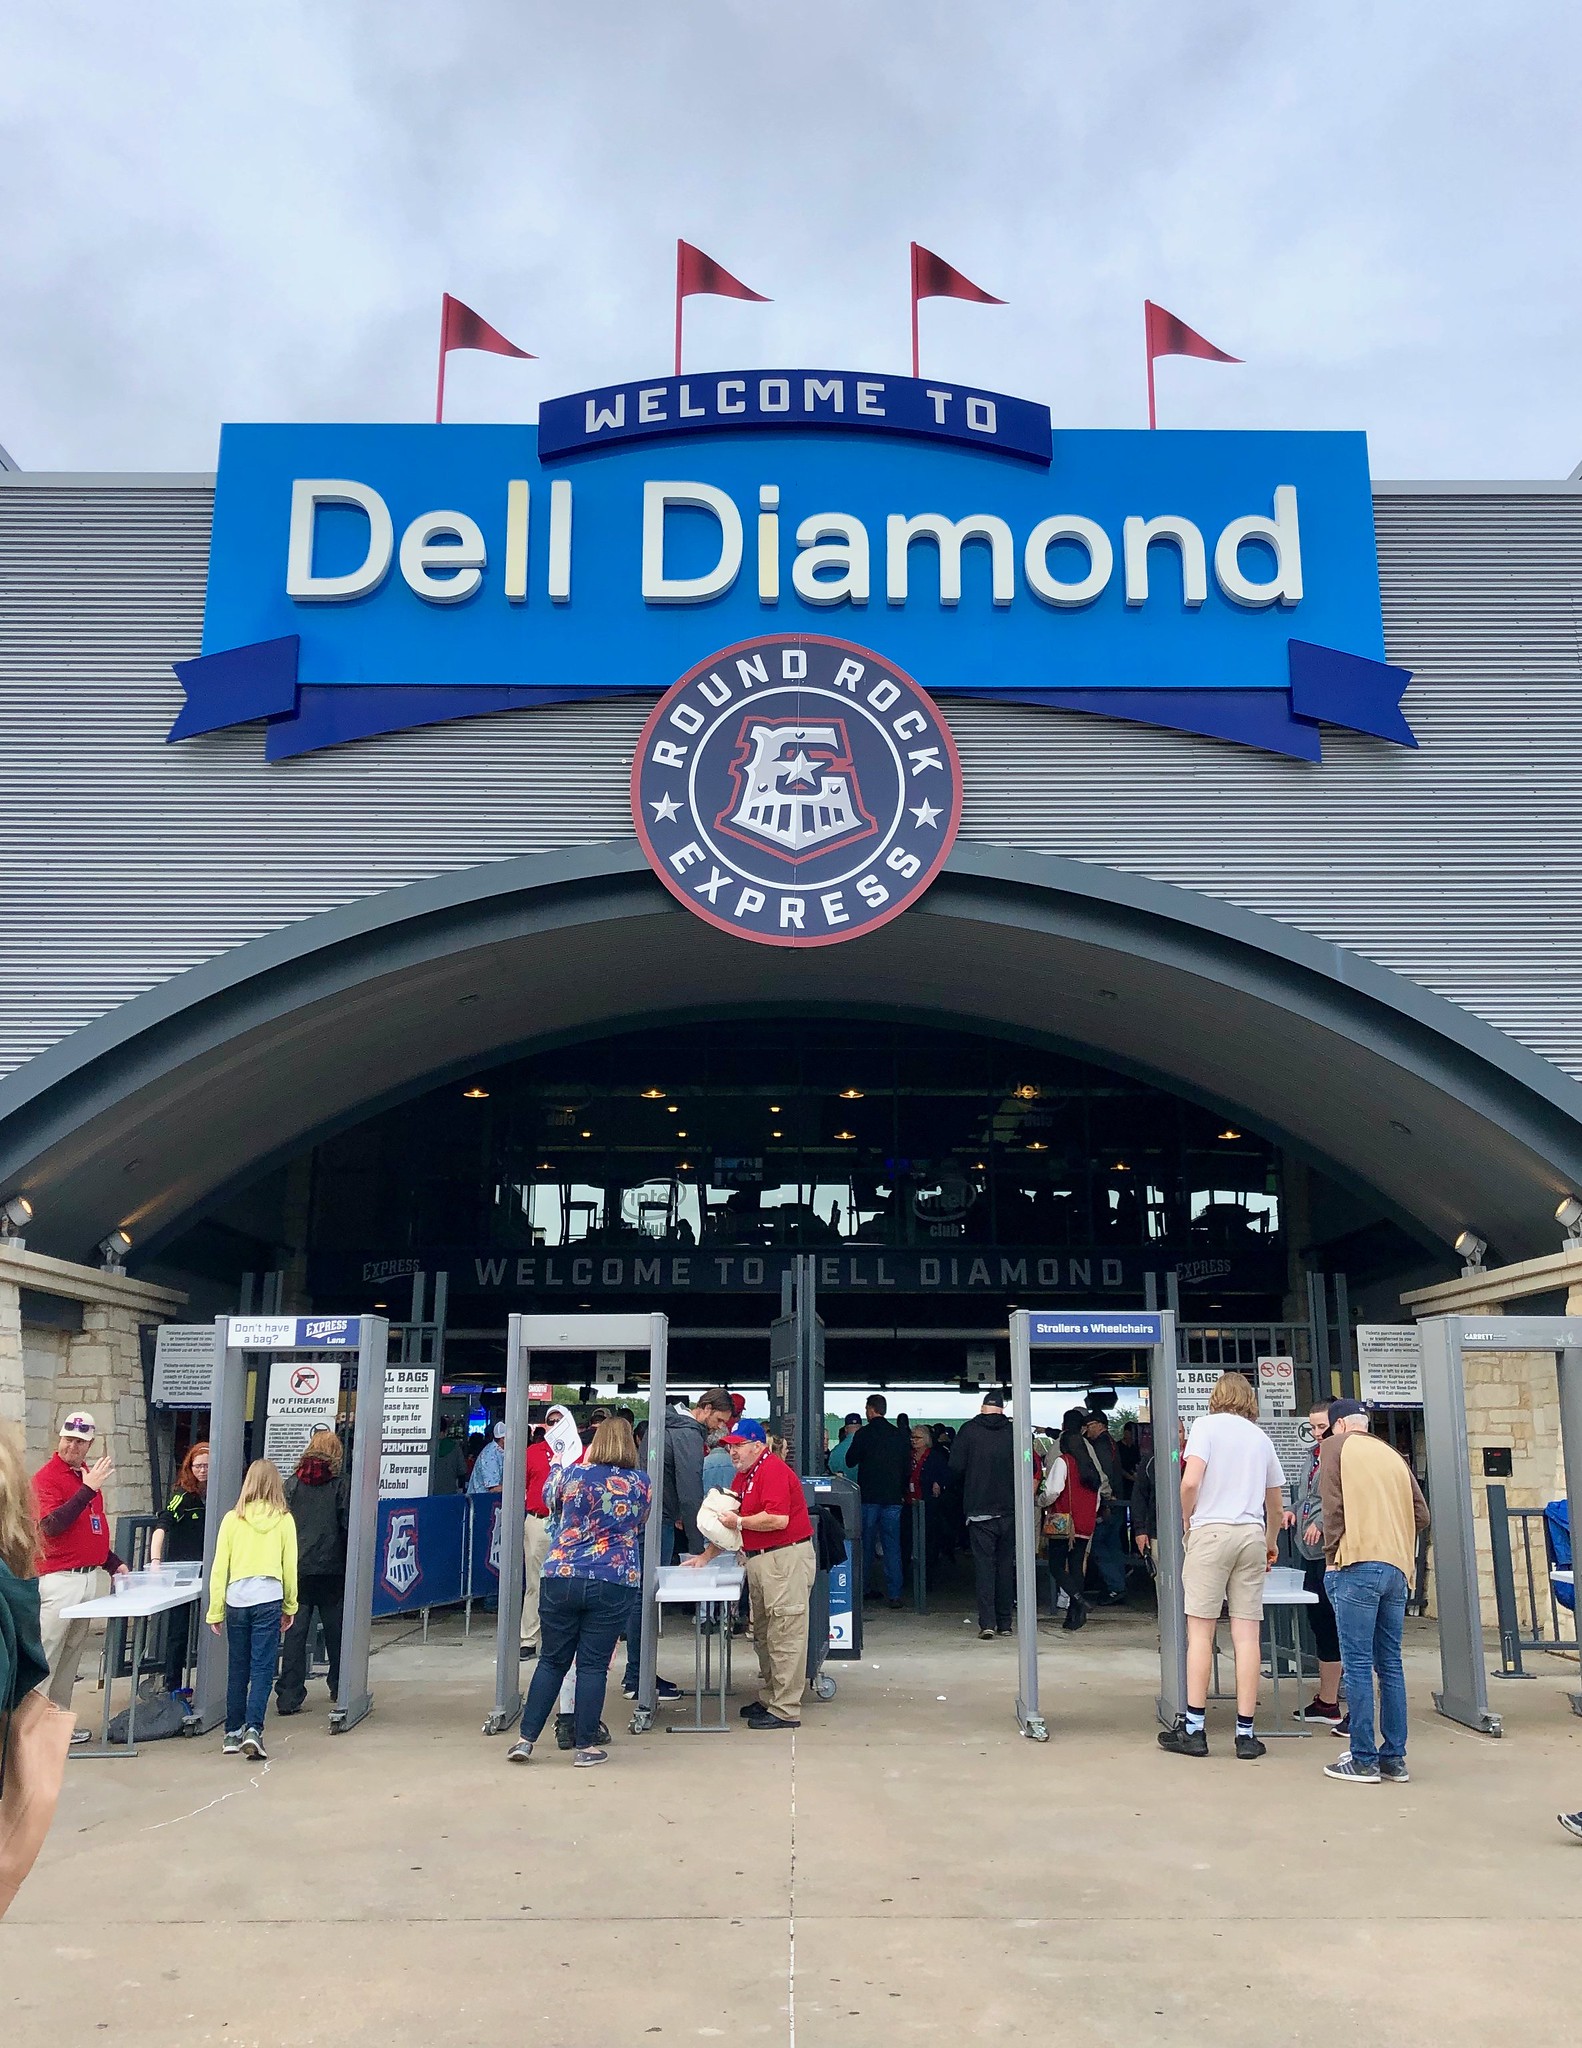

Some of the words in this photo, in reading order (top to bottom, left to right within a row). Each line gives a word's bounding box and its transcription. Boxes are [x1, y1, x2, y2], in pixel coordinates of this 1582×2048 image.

[585, 378, 886, 433] WELCOME
[926, 389, 997, 434] TO
[286, 479, 572, 603] Dell
[641, 481, 1303, 607] Diamond
[651, 649, 807, 769] ROUND
[833, 657, 944, 777] ROCK
[668, 840, 922, 929] EXPRESS
[361, 1258, 421, 1282] EXPRESS
[474, 1258, 691, 1285] WELCOME
[714, 1258, 764, 1285] TO
[920, 1258, 1123, 1286] DIAMOND
[1174, 1259, 1231, 1281] EXPRESS
[235, 1323, 262, 1332] Don't
[264, 1323, 290, 1333] have
[305, 1320, 348, 1337] EXPRESS
[1036, 1323, 1081, 1333] Strollers
[1082, 1325, 1088, 1333] &
[1090, 1323, 1154, 1334] Wheelchairs
[253, 1334, 279, 1345] bag?
[326, 1336, 346, 1344] Lane
[398, 1372, 428, 1382] BAGS
[1178, 1373, 1185, 1382] L
[1188, 1373, 1218, 1383] BAGS
[384, 1385, 395, 1393] ect
[396, 1385, 403, 1393] to
[404, 1385, 429, 1393] search
[1188, 1386, 1195, 1394] to
[402, 1402, 419, 1410] have
[1196, 1402, 1209, 1411] hav
[392, 1414, 409, 1424] open
[411, 1413, 422, 1421] for
[390, 1425, 427, 1436] inspection
[382, 1442, 428, 1453] PERMITTED
[389, 1463, 427, 1476] Beverage
[379, 1479, 409, 1490] Alcohol
